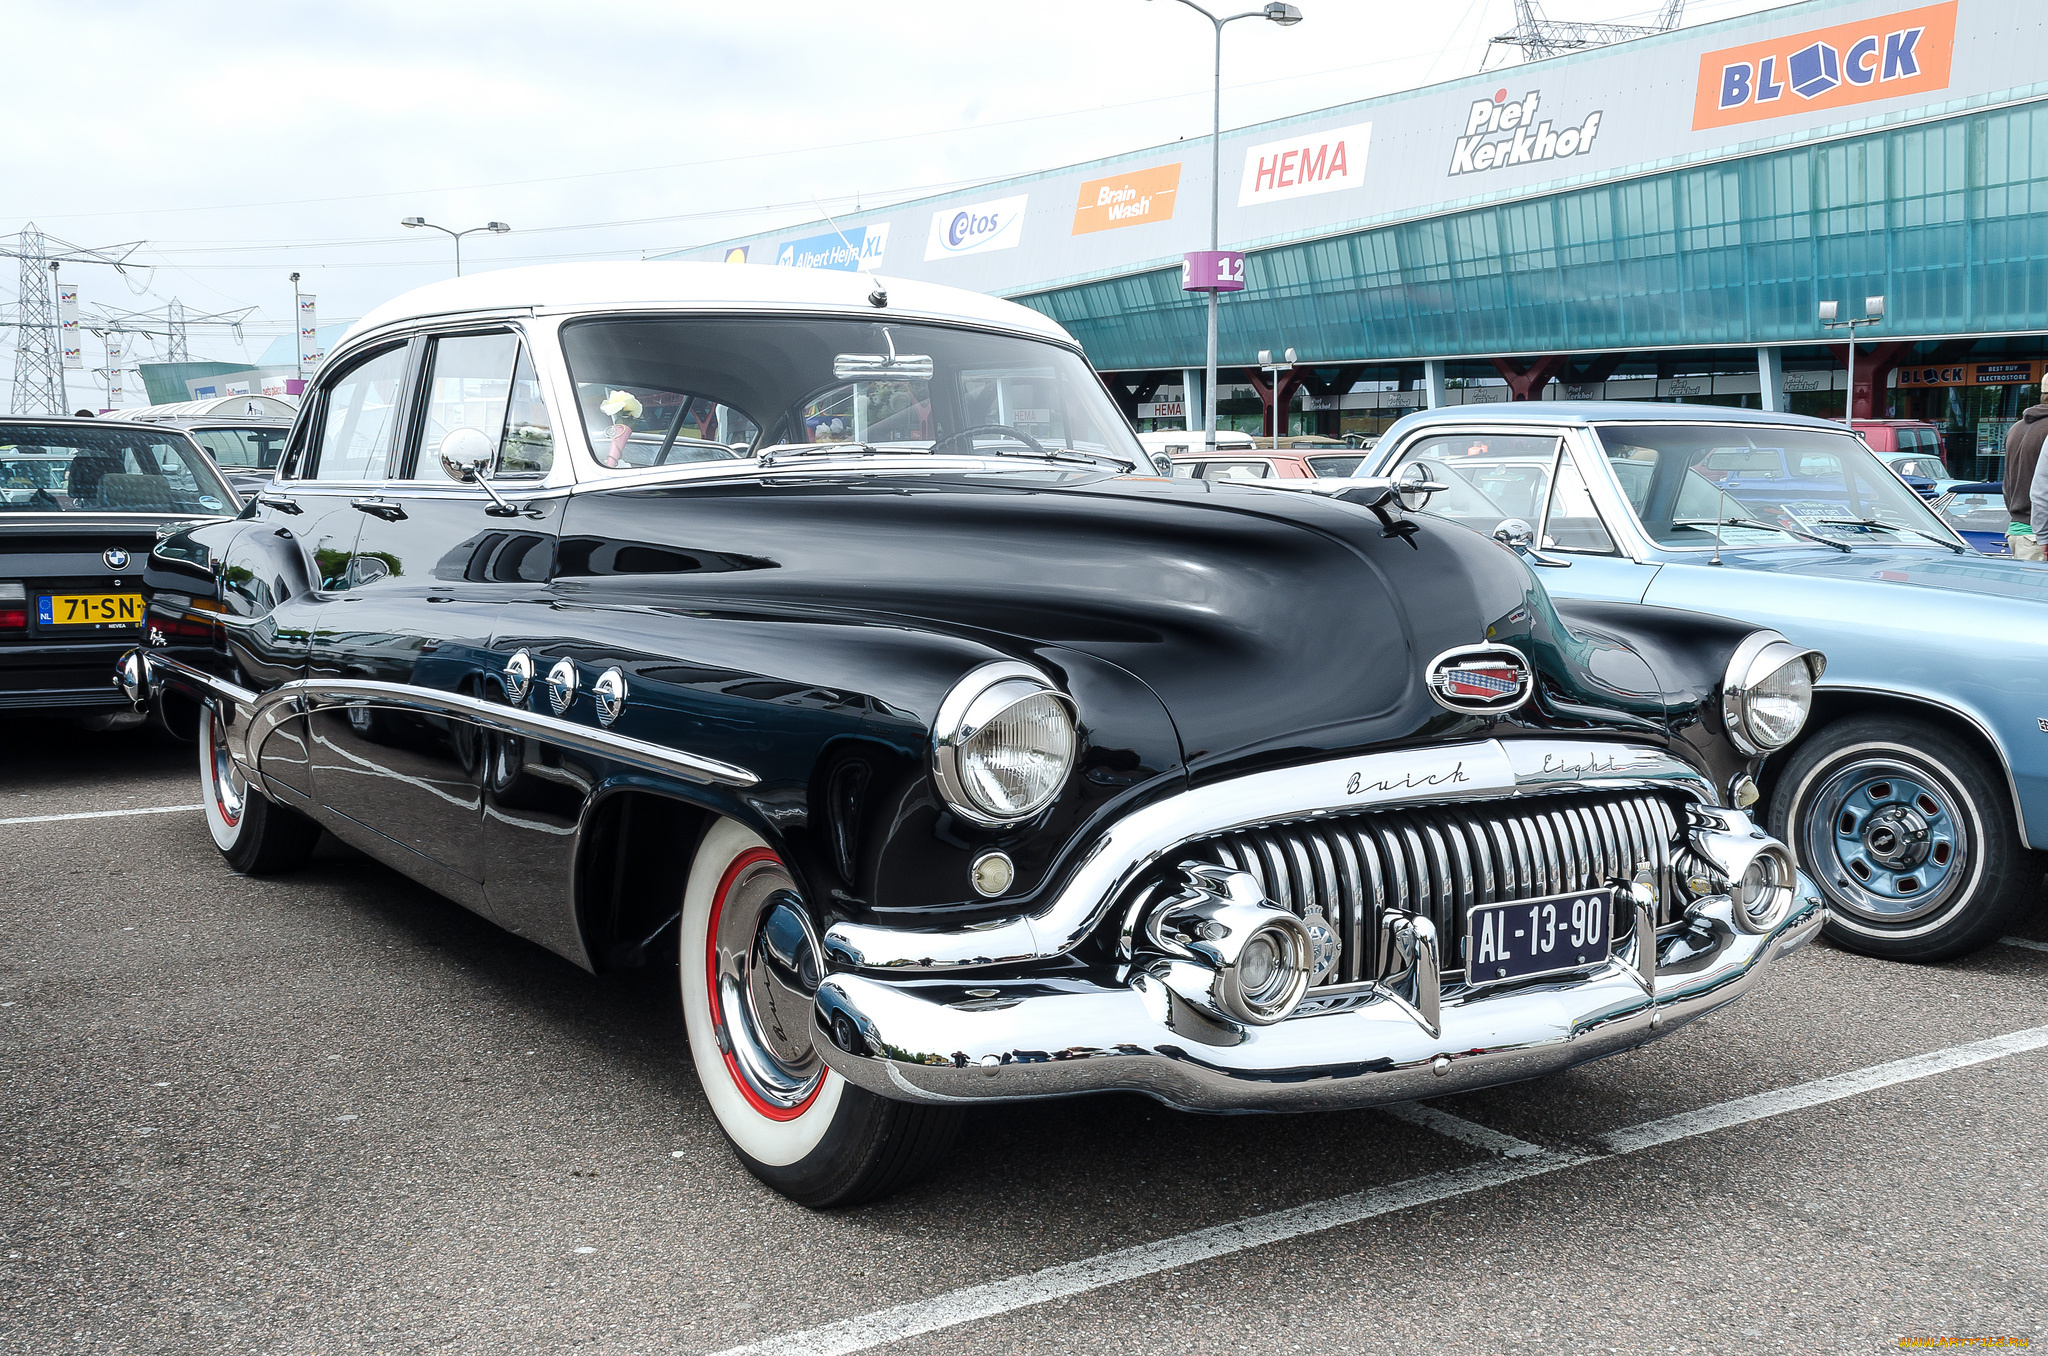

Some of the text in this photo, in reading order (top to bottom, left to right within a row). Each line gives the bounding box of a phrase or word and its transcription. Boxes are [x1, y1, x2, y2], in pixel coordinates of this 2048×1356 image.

[1465, 88, 1541, 137] Piet
[1448, 110, 1603, 177] Kerkhof
[1255, 141, 1347, 192] HEMA
[1097, 186, 1136, 206] Brain
[796, 245, 829, 267] Albert
[829, 243, 860, 265] Heijn
[862, 235, 883, 258] XL
[1217, 257, 1245, 282] 12
[1671, 379, 1687, 388] Piet
[1786, 374, 1804, 383] Piet
[1978, 374, 2027, 382] ELECTROSTORE
[1568, 384, 1582, 393] Piet
[1668, 385, 1700, 395] Kerkhof
[1783, 381, 1819, 391] Kerkhof
[1566, 391, 1594, 400] Kerkhof
[1014, 410, 1037, 421] HEMA
[1154, 403, 1182, 416] HEMA
[1346, 752, 1621, 794] Buick Eight
[1478, 897, 1601, 964] AL-13-90
